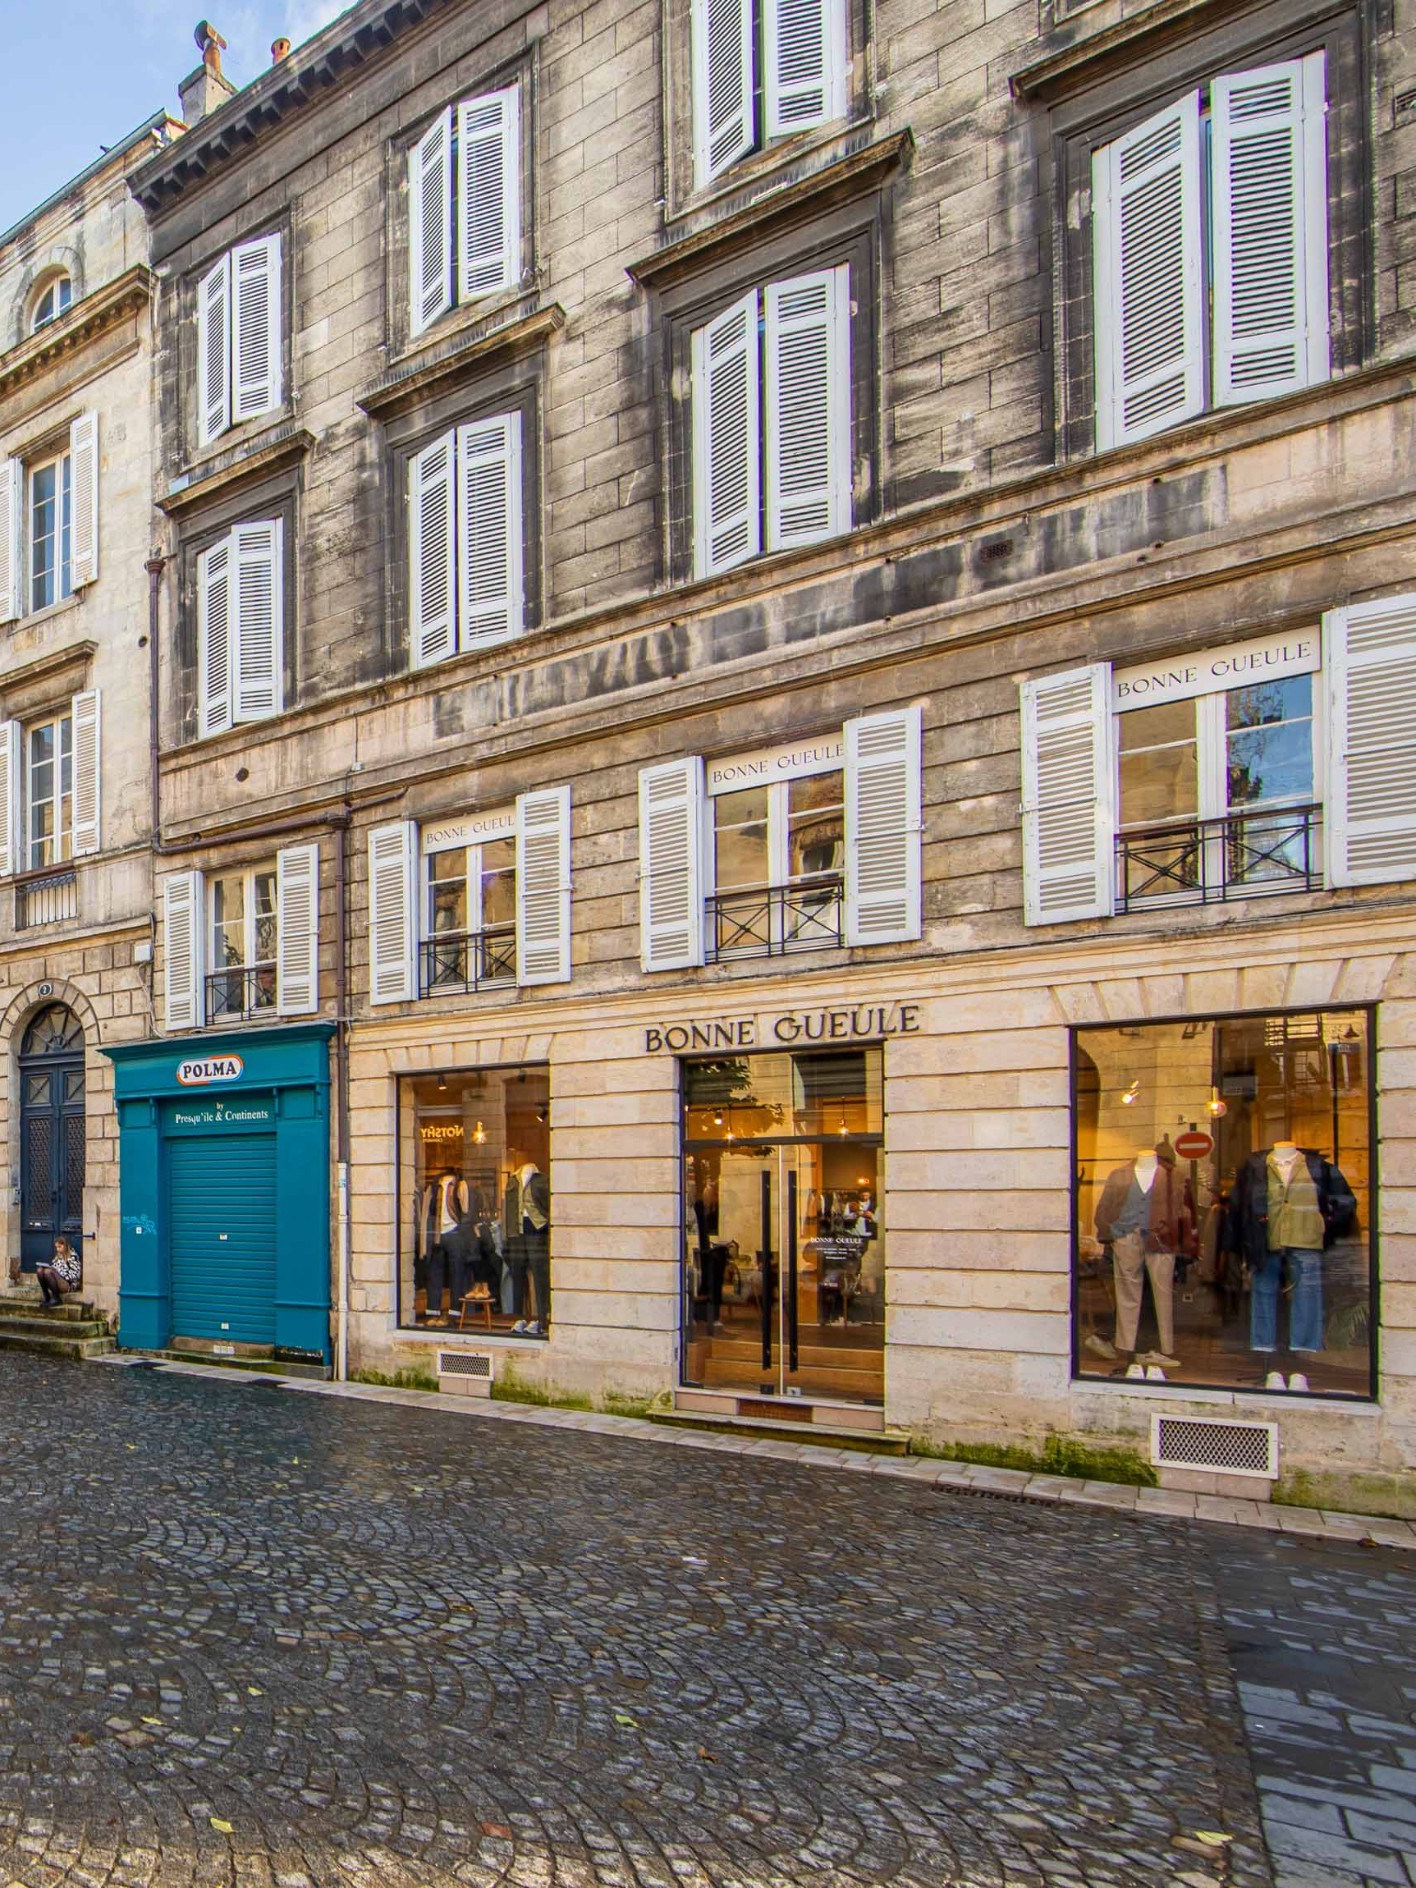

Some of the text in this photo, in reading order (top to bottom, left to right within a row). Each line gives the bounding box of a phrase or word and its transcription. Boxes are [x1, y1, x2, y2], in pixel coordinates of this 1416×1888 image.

[1117, 641, 1312, 698] BONNE GUEULE
[713, 744, 844, 783] BONNE GUEULE
[426, 815, 515, 844] BONNE GUEUL
[645, 1005, 920, 1052] BONNE GUEULE
[183, 1061, 237, 1079] POLMA
[215, 1111, 222, 1121] &
[225, 1109, 269, 1121] Continents
[216, 1102, 224, 1111] by
